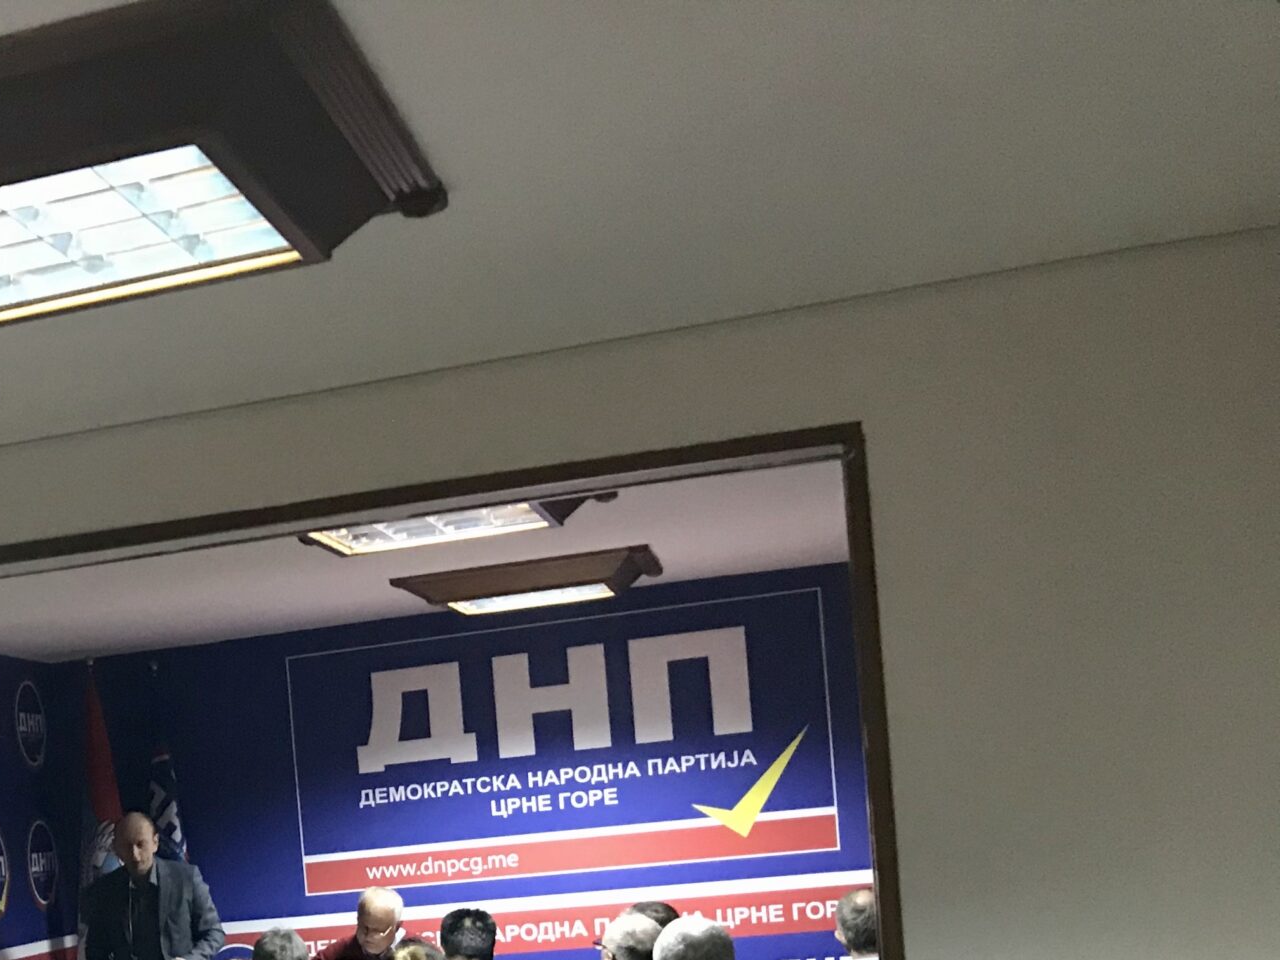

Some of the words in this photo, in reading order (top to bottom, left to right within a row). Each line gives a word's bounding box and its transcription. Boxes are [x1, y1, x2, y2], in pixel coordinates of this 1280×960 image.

[357, 626, 753, 774] ДНП
[19, 712, 44, 732] ДНП
[358, 772, 522, 809] ДЕМОКРАТСКА
[527, 758, 641, 788] НАРОДНА
[647, 748, 758, 776] ПАРТИЈА
[490, 790, 553, 818] ЦРНЕ
[558, 787, 619, 811] ГОРЕ
[30, 852, 54, 873] ДНП
[365, 851, 519, 880] www.dnpcg.me
[495, 918, 588, 946] АРОДНА
[715, 903, 785, 929] ЦРНЕ
[791, 900, 840, 922] ГОР
